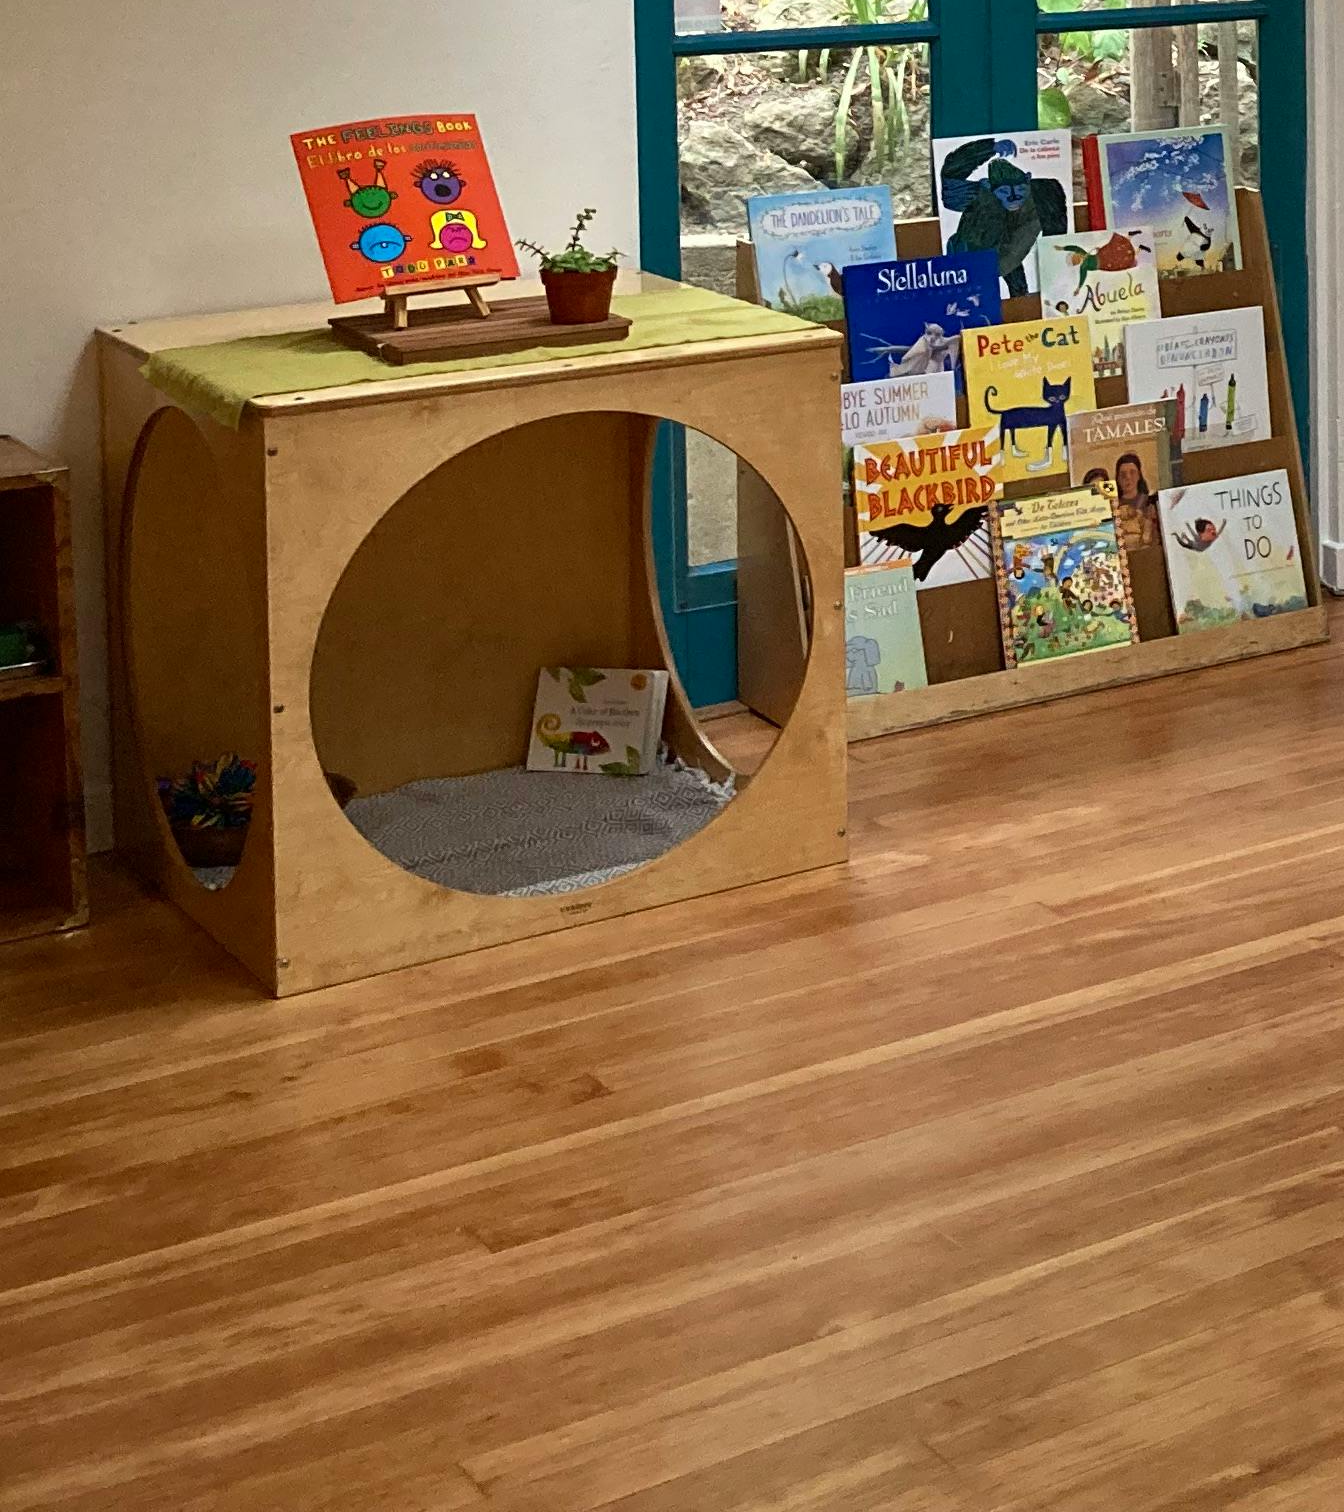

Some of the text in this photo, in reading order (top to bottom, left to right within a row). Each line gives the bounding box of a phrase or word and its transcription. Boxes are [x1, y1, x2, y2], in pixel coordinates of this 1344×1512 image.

[302, 119, 473, 150] THE FEELINGS BOOK
[368, 144, 384, 157] de
[387, 142, 407, 156] los
[770, 205, 874, 229] THE DANDELION'S TALE
[877, 261, 968, 294] Stellaluna
[1076, 271, 1145, 314] Abuela
[976, 325, 1080, 358] Pete the Cat
[874, 381, 929, 406] SUMMER
[866, 403, 920, 428] AUTUMN
[1083, 416, 1166, 443] TAMALES!
[865, 440, 992, 486] BEAUTIFUL
[867, 475, 996, 522] BLACKBIRD
[1031, 502, 1046, 514] De
[1214, 481, 1283, 510] THINGS
[1243, 514, 1263, 531] TO
[1244, 535, 1272, 560] DO
[847, 575, 910, 602] Friend
[863, 599, 898, 620] Sad
